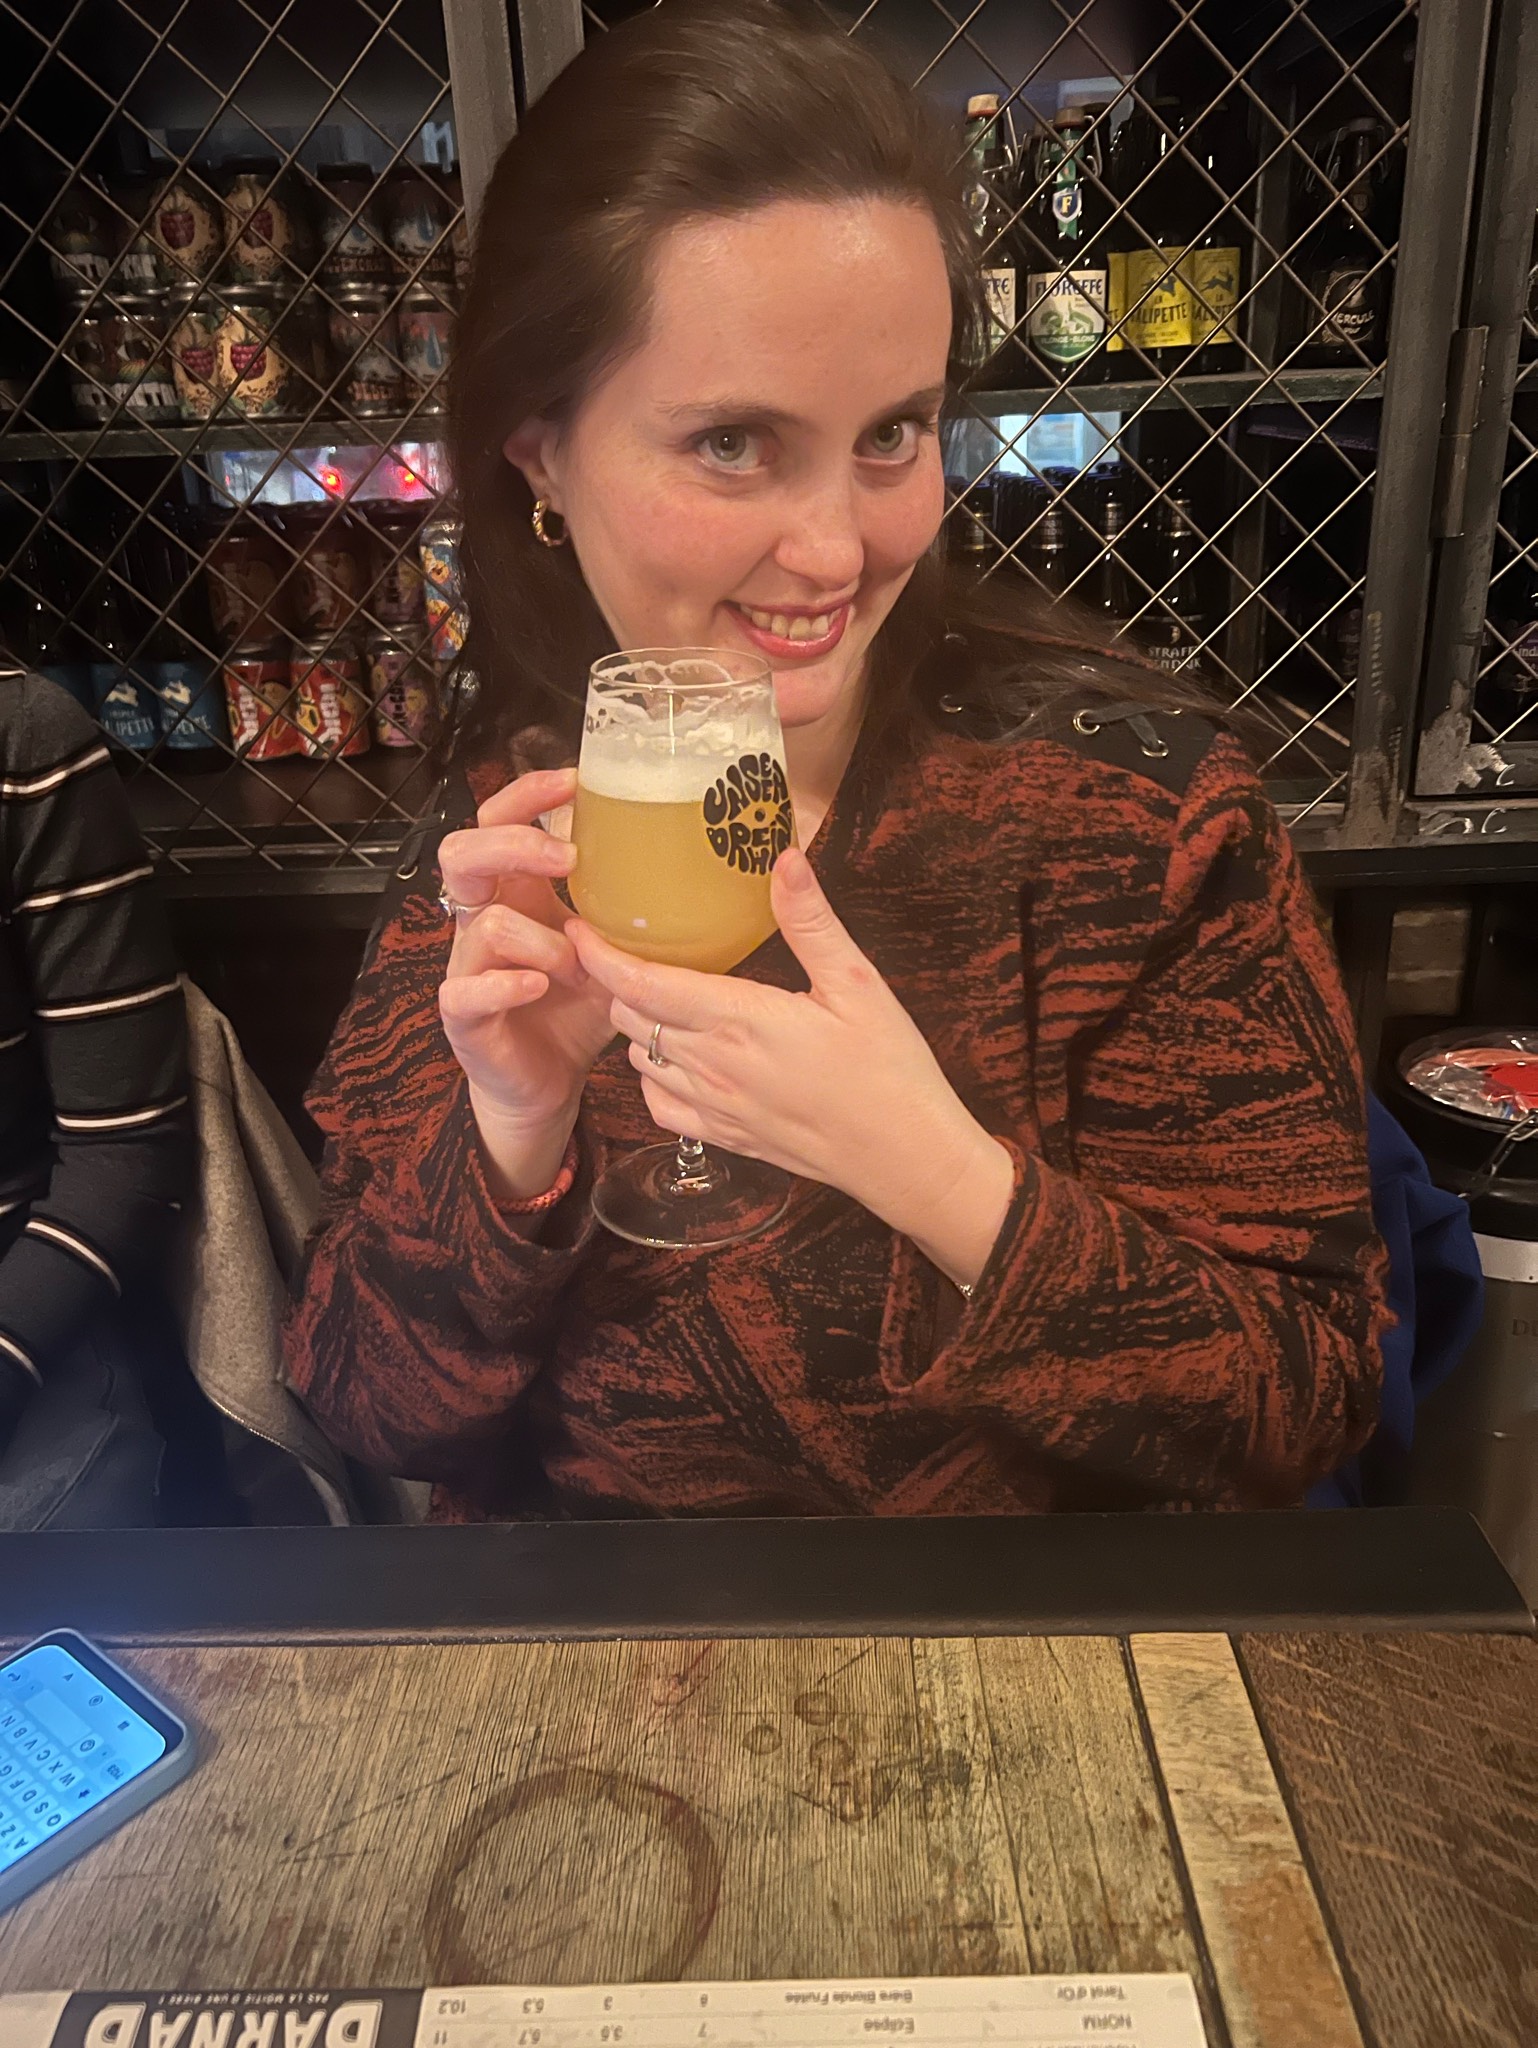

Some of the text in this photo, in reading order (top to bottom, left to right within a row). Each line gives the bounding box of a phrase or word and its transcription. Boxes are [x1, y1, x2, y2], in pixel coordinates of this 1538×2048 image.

[1061, 196, 1073, 213] F
[1, 1715, 76, 1787] W X C V B N
[9, 1779, 25, 1790] F
[22, 1789, 37, 1802] D
[34, 1801, 49, 1815] S
[0, 1824, 29, 1850] A Z
[306, 1992, 330, 2005] PAS
[697, 2022, 708, 2038] 7
